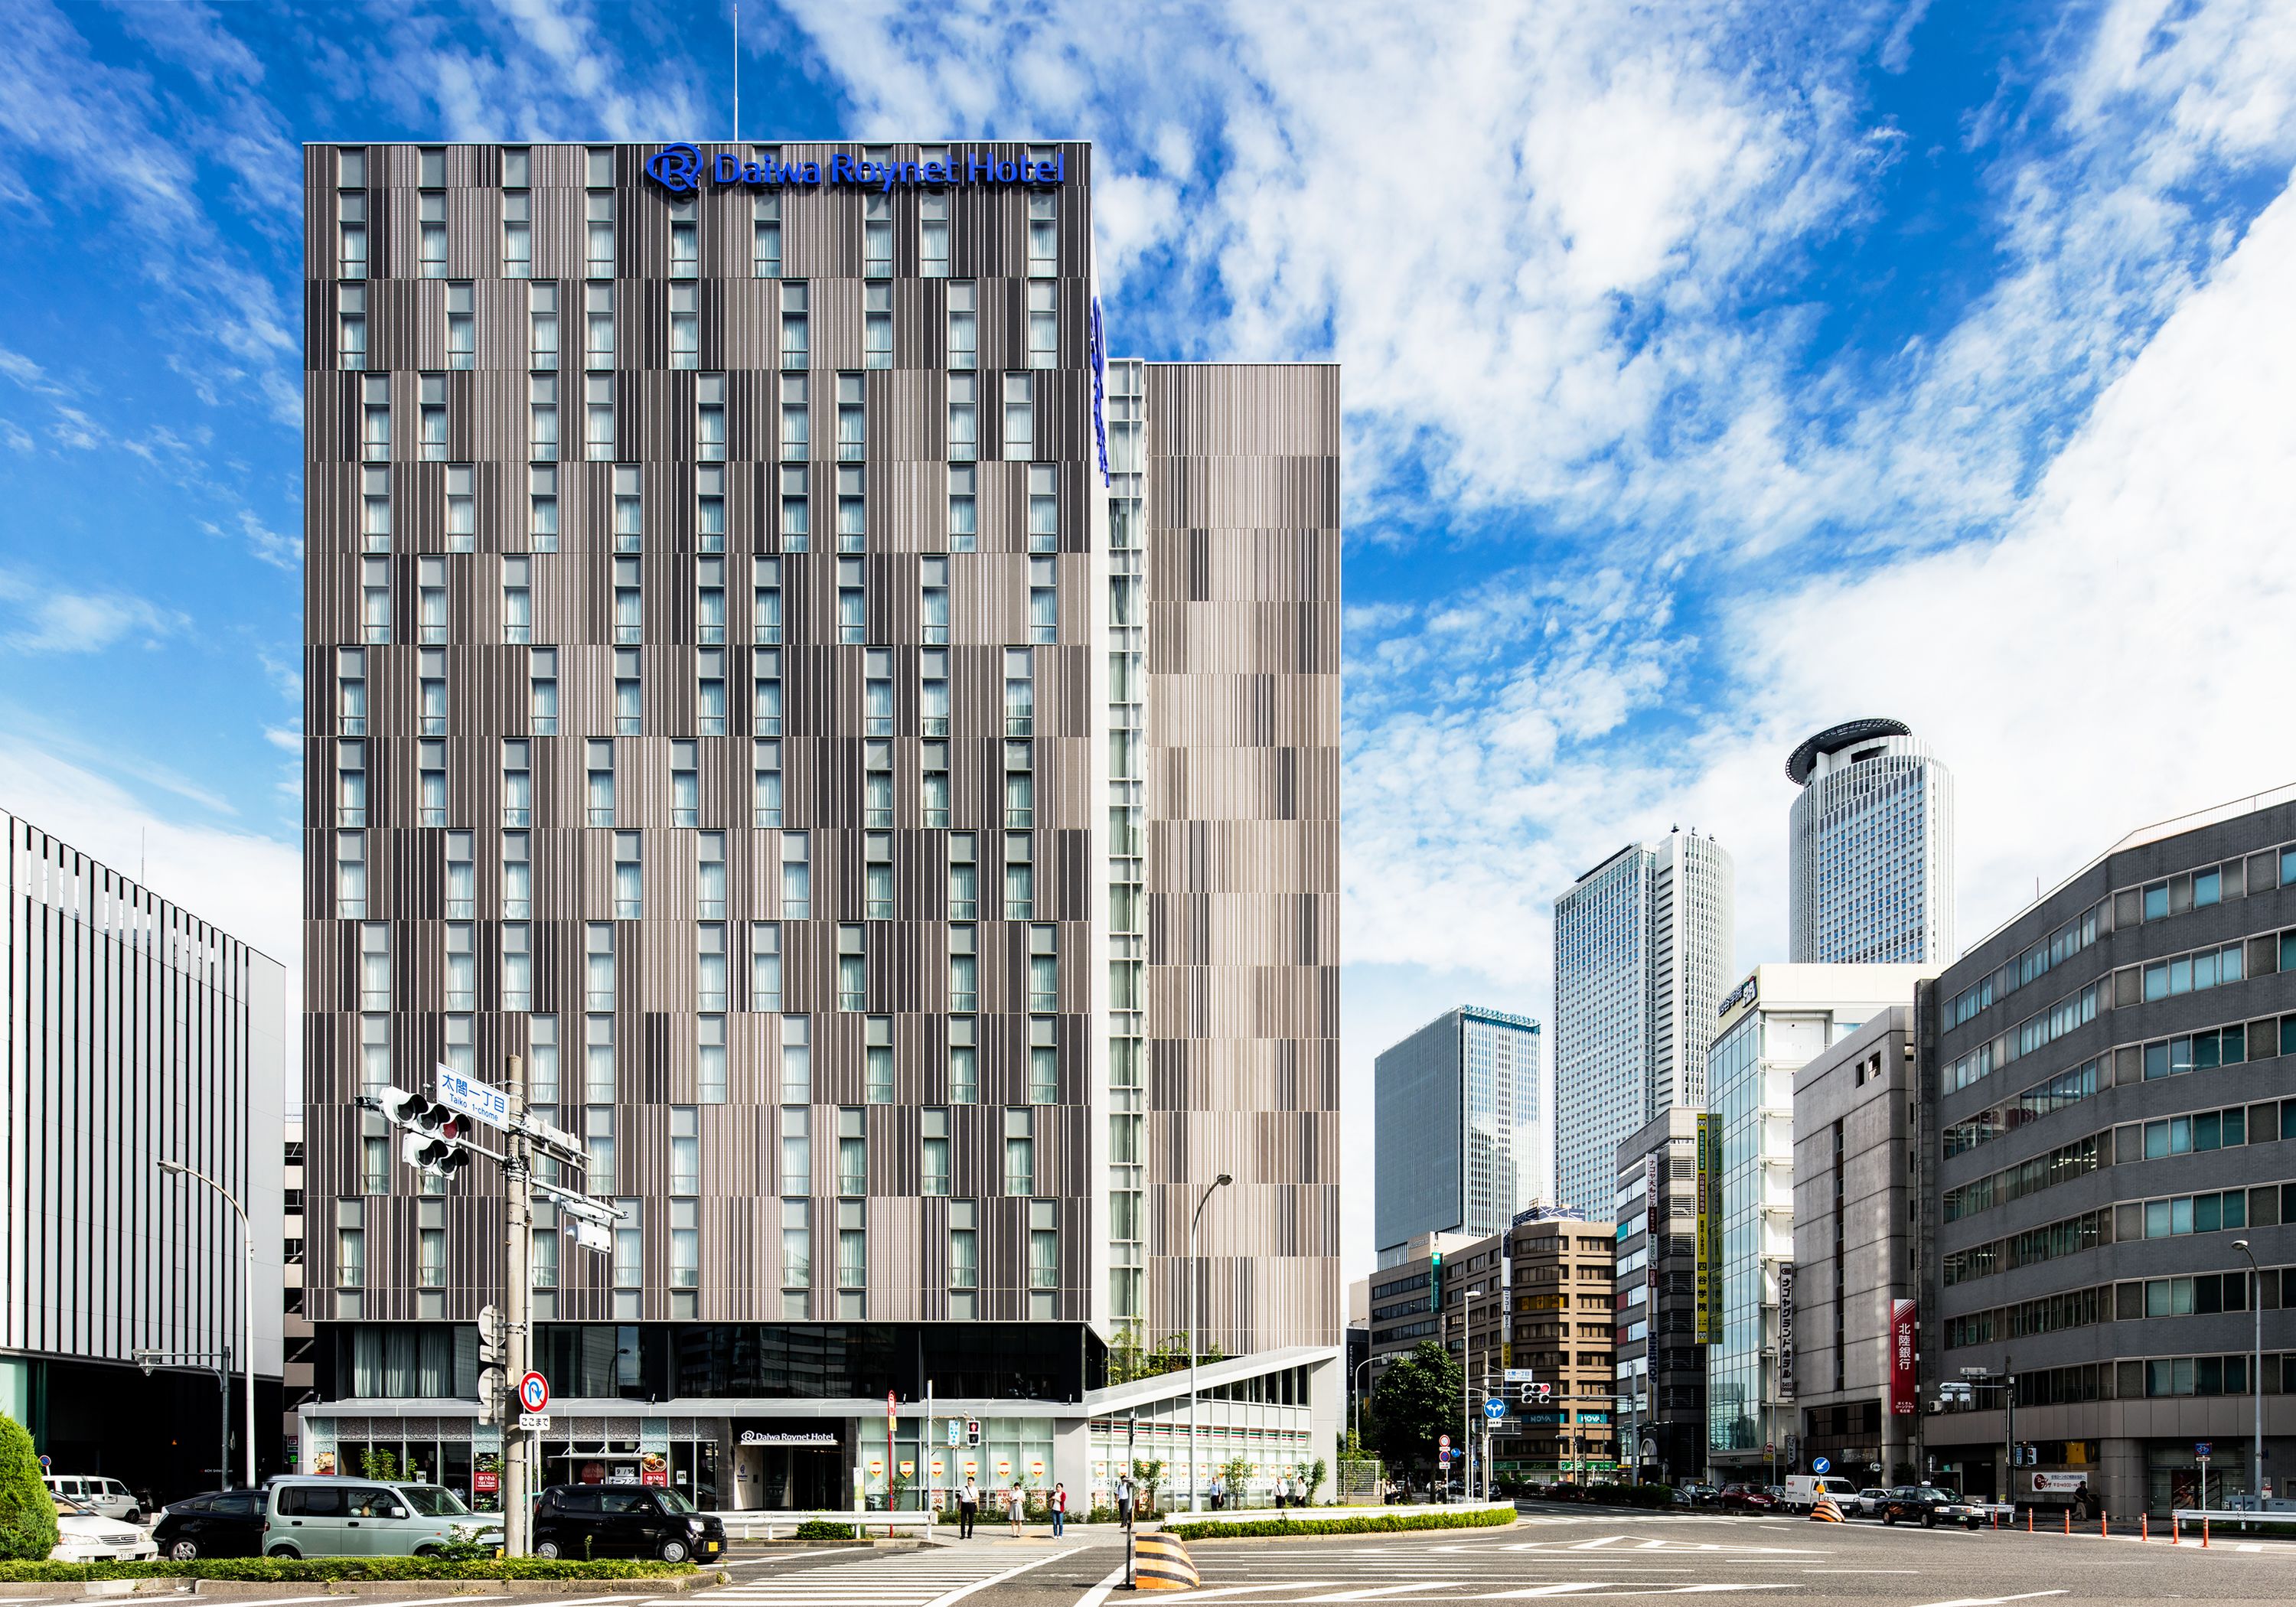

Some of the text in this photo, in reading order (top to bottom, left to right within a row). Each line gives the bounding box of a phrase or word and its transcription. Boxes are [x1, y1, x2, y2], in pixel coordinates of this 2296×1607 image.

[715, 153, 821, 184] Daiwa
[832, 153, 959, 193] Roynet
[968, 152, 1065, 184] Hotel
[442, 1074, 504, 1113] 太閤一丁目
[449, 1093, 498, 1121] Taiko 1-chome
[1697, 1262, 1707, 1312] 四谷学院
[1782, 1278, 1792, 1378] ナゴヤグランドホテル
[1898, 1322, 1911, 1370] 北陸銀行
[1648, 1332, 1657, 1383] MINISTOP
[521, 1417, 549, 1426] ここまで
[756, 1433, 780, 1441] Daiwa
[781, 1433, 810, 1442] Roynet
[811, 1433, 833, 1441] Hotel
